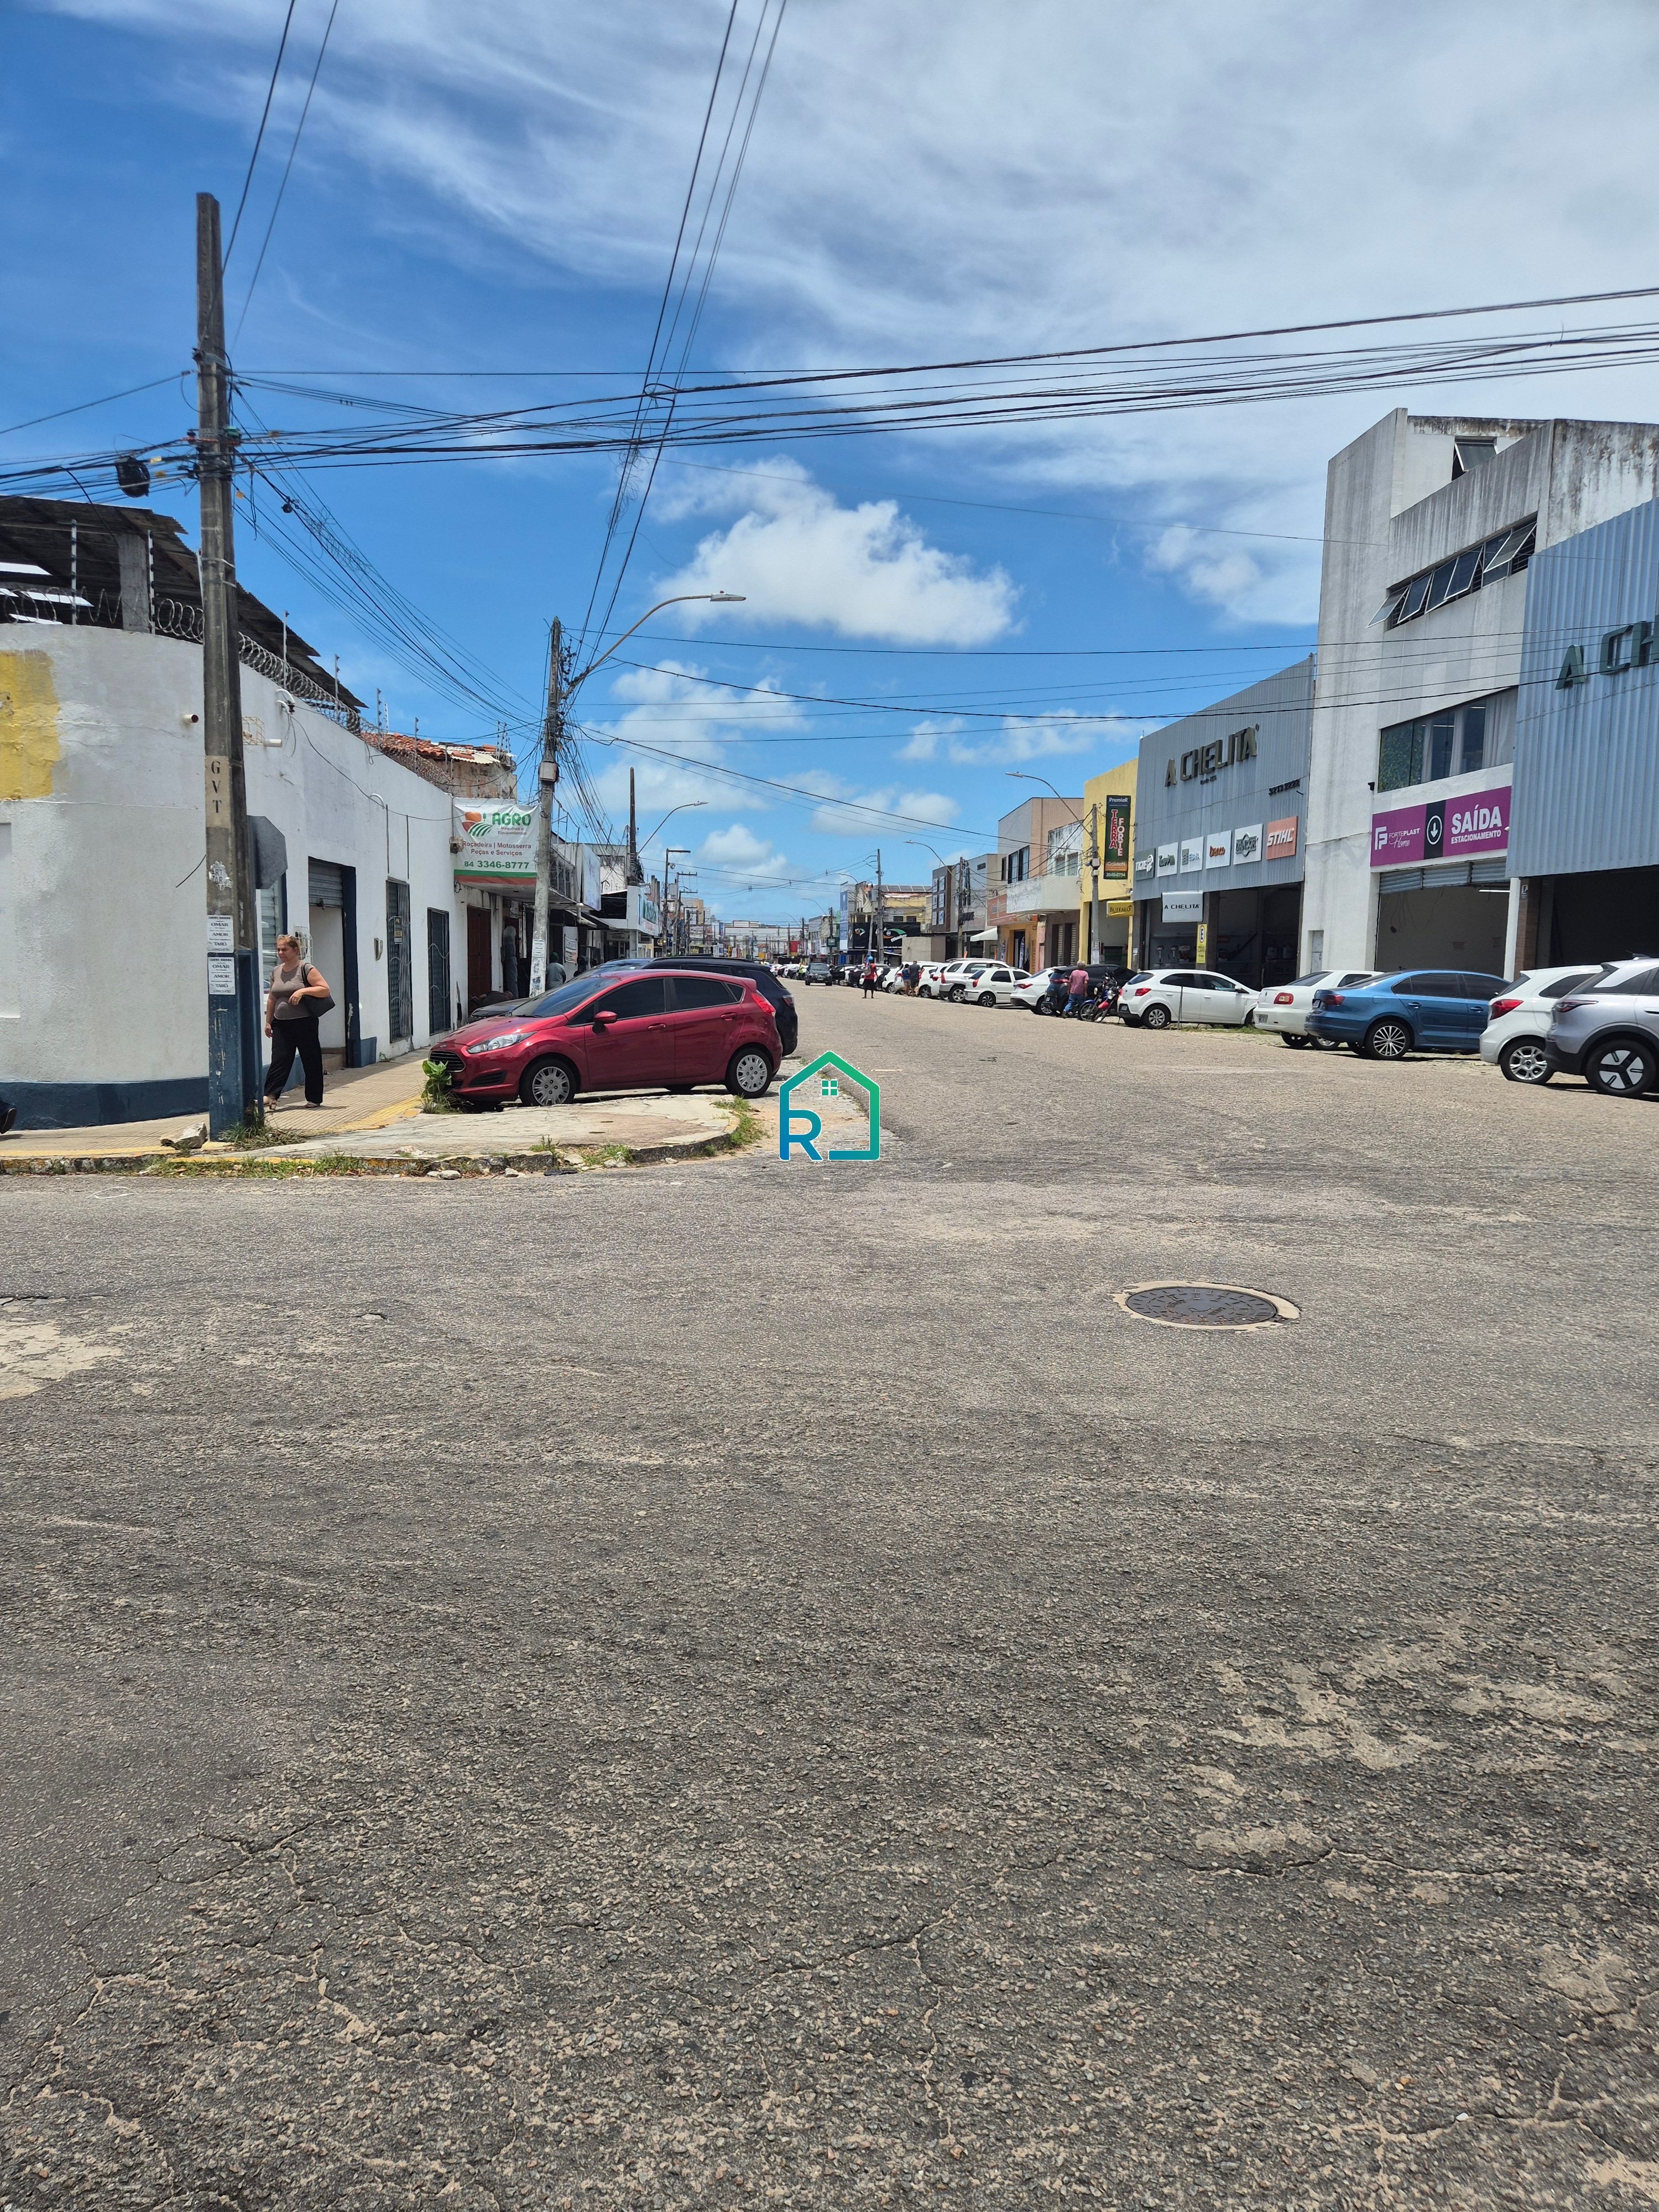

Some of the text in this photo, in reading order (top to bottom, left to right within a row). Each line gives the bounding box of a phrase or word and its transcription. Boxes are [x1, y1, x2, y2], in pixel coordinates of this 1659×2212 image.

[1165, 727, 1257, 787] A CHELITA
[492, 811, 531, 826] AGRO
[1451, 804, 1502, 835] SAÍDA
[1109, 809, 1118, 849] TERRA
[1117, 818, 1125, 856] FORTE
[1389, 827, 1420, 839] FORTEPLAST
[1266, 829, 1293, 847] STIHL
[1389, 835, 1410, 848] Home
[1451, 830, 1501, 845] ESTACIONAMENTO
[477, 860, 530, 869] 3346-8777
